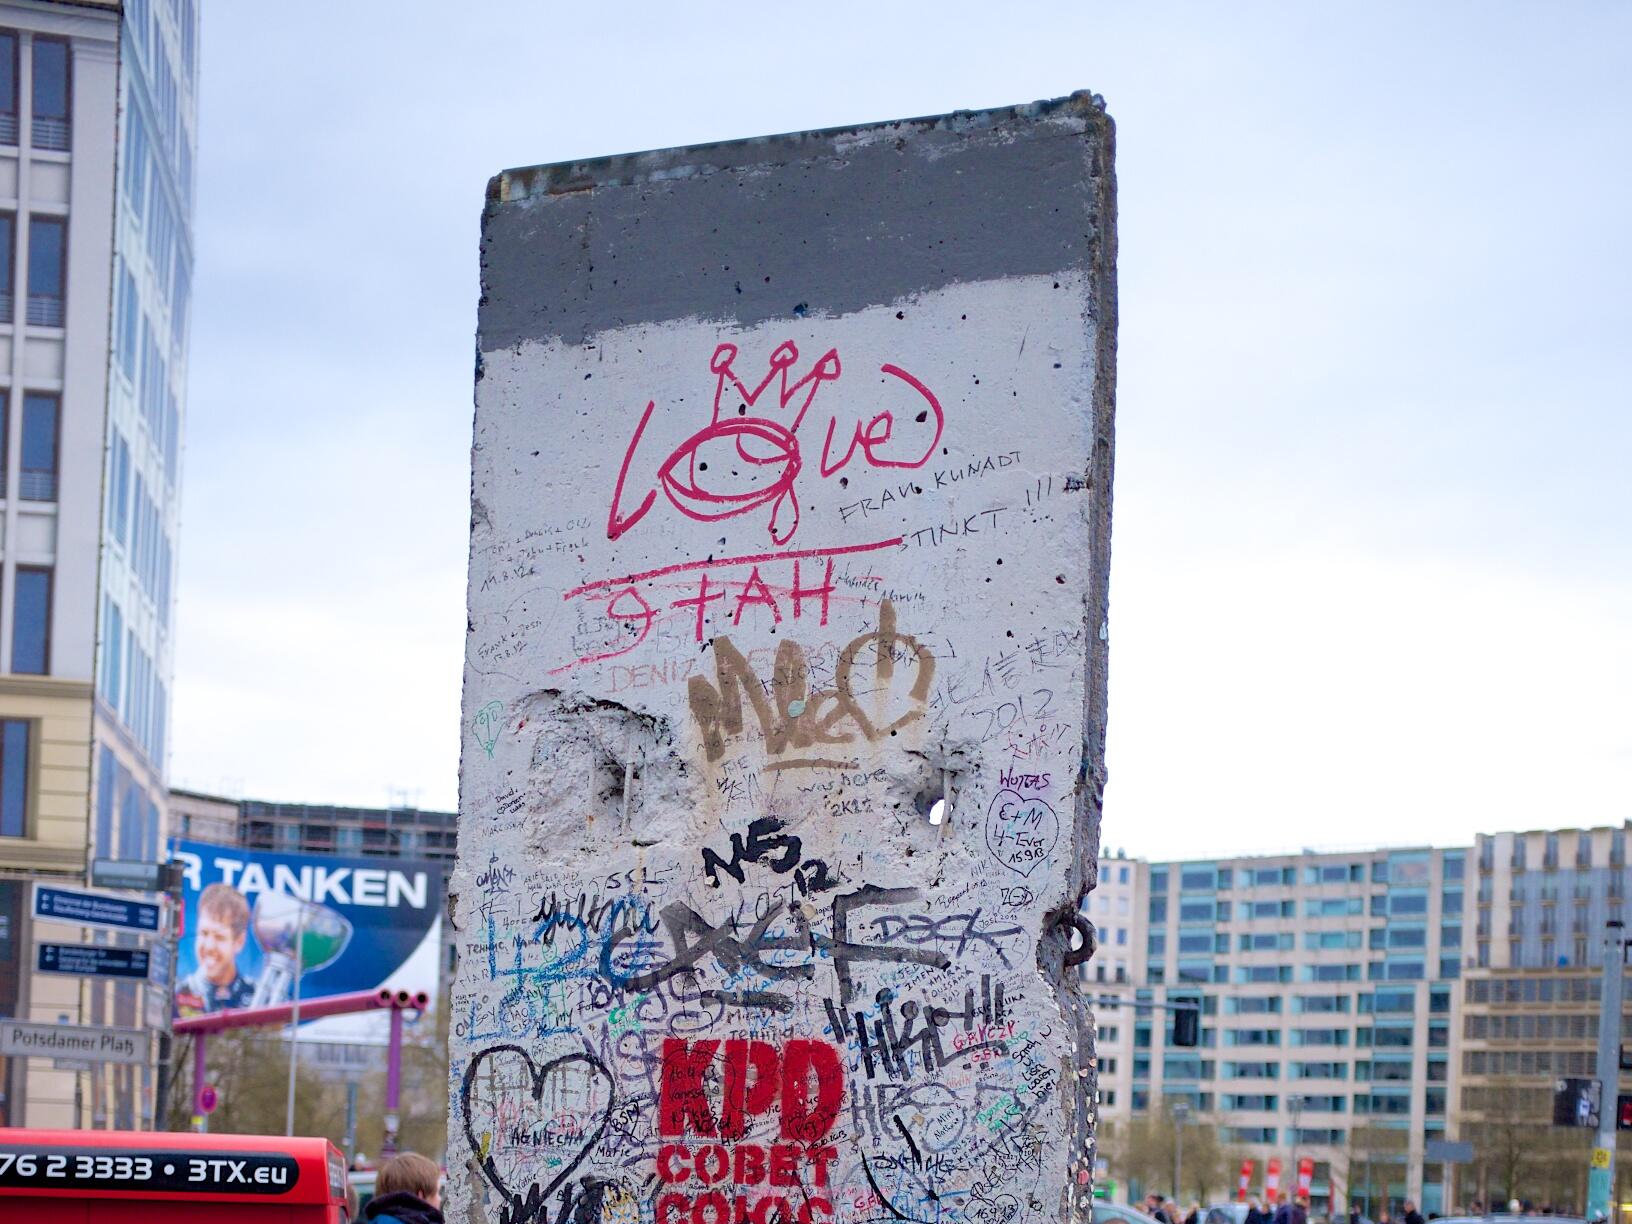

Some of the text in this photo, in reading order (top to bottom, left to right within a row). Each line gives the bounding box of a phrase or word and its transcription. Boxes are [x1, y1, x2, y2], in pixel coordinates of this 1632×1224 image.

[213, 857, 429, 909] TANKEN
[12, 1028, 96, 1051] Potsdamer
[658, 1038, 845, 1141] KPD
[46, 1155, 68, 1178] 2
[75, 1155, 153, 1180] 3333
[187, 1159, 288, 1185] 3TX.eu
